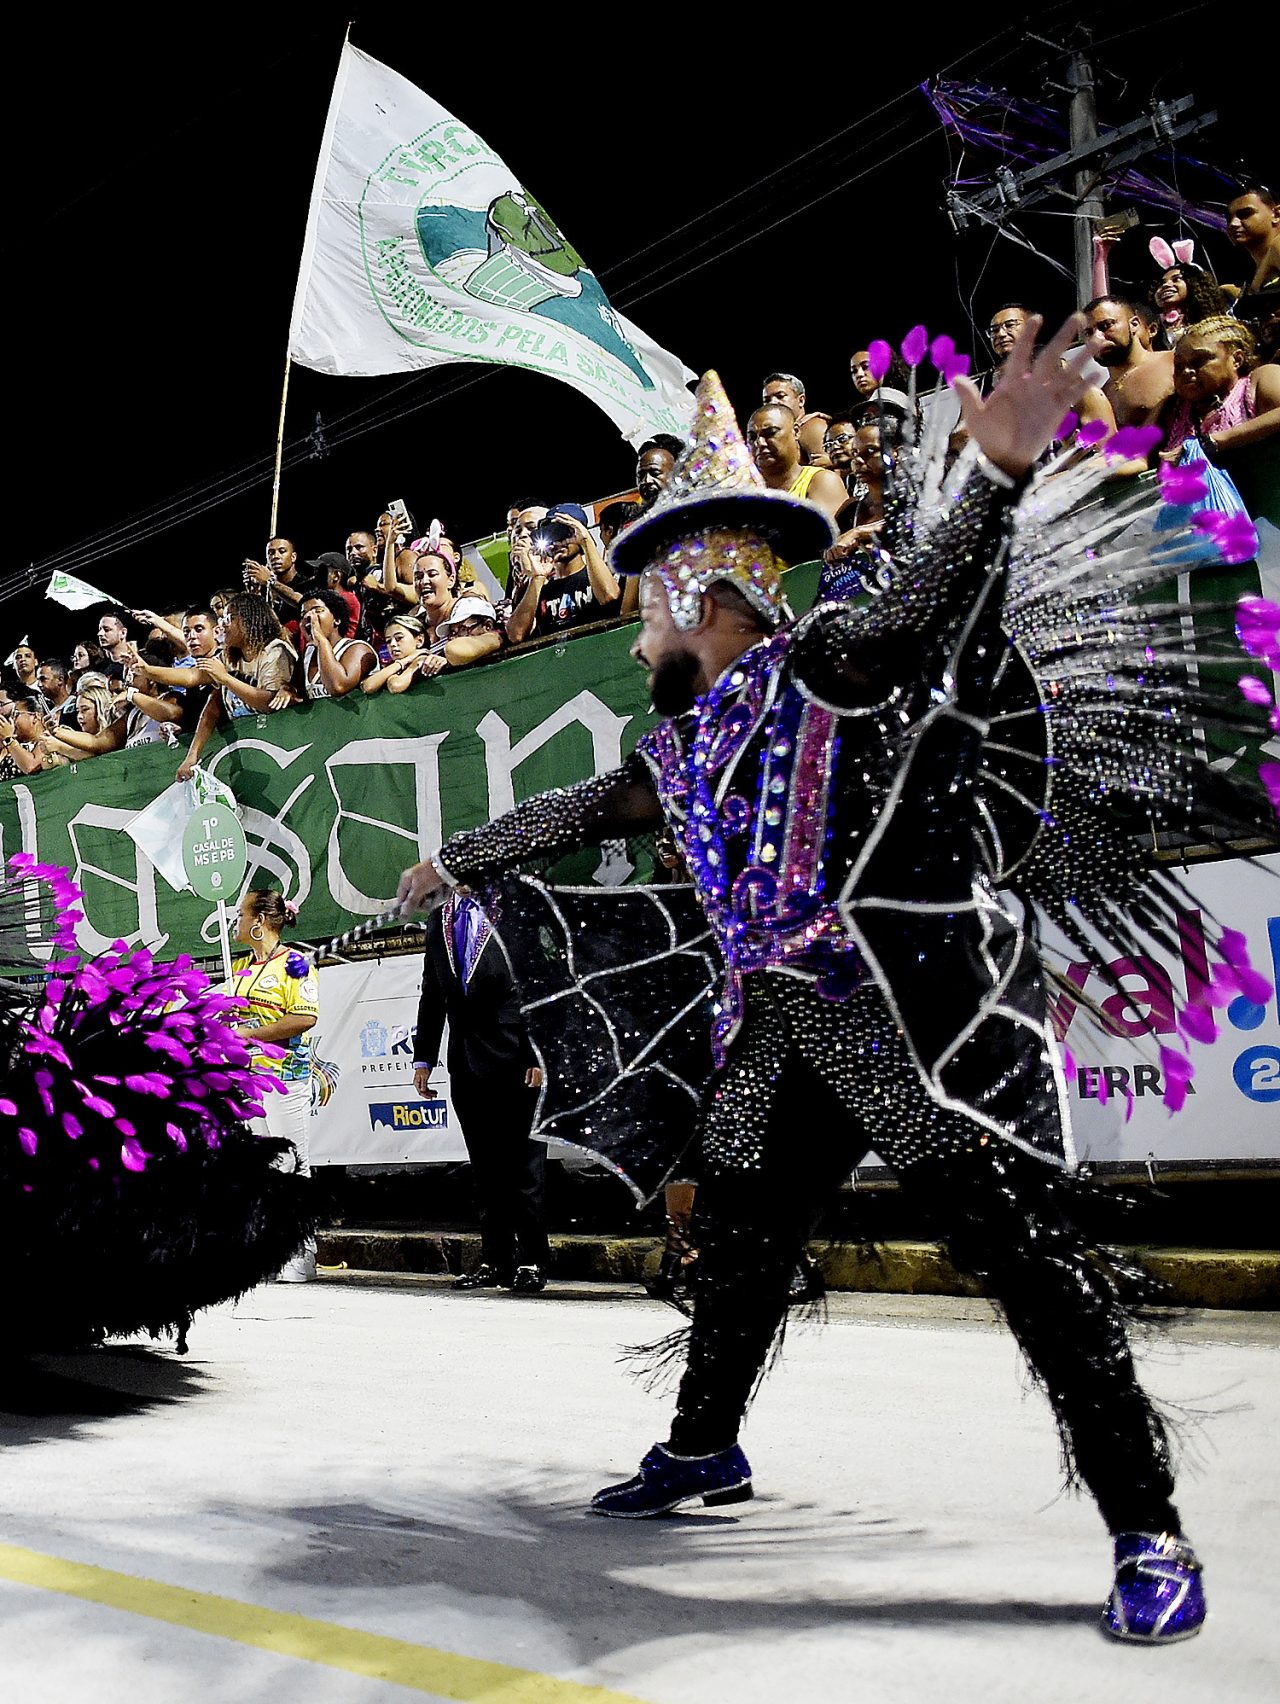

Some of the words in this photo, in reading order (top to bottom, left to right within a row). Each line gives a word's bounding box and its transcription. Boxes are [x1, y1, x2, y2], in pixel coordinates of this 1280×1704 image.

[496, 324, 569, 367] PELA
[192, 840, 221, 854] CASAL
[221, 837, 234, 850] DE
[193, 854, 210, 867] MS
[211, 852, 219, 863] E
[219, 848, 236, 862] PB
[361, 1060, 445, 1073] PREFEITA
[393, 1104, 447, 1128] Riotur
